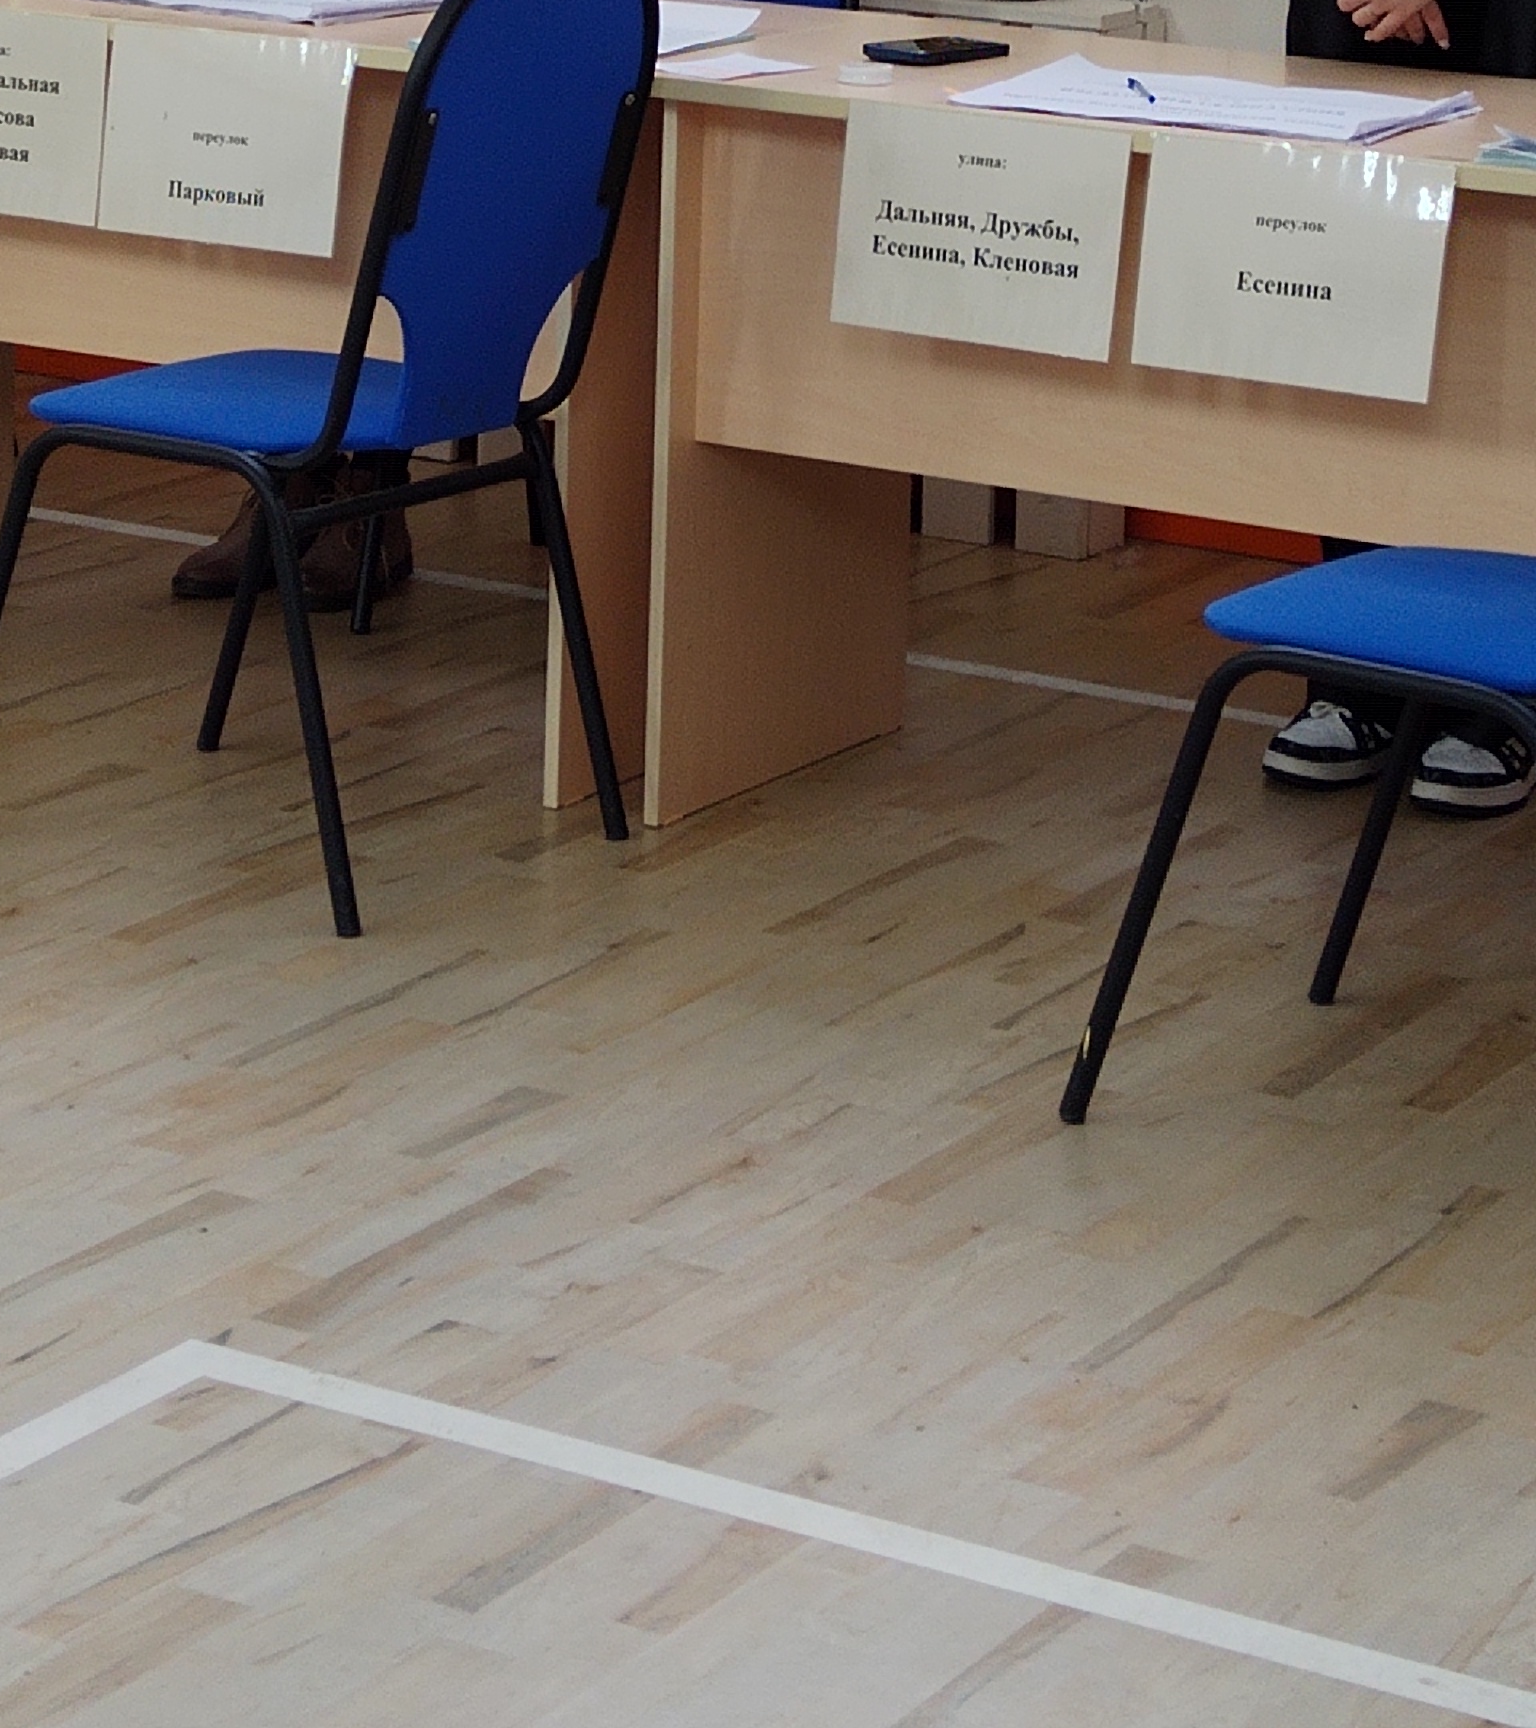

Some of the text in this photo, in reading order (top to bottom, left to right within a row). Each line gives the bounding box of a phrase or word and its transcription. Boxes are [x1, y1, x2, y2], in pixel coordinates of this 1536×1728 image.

[192, 129, 249, 148] переулок
[957, 153, 1007, 172] улица:
[167, 179, 265, 208] Парковый
[875, 199, 1081, 247] Дальняя, Дружбы,
[1255, 212, 1328, 234] переулок
[871, 234, 1080, 280] Есенина, Кленовая
[1236, 270, 1332, 302] Есенина
